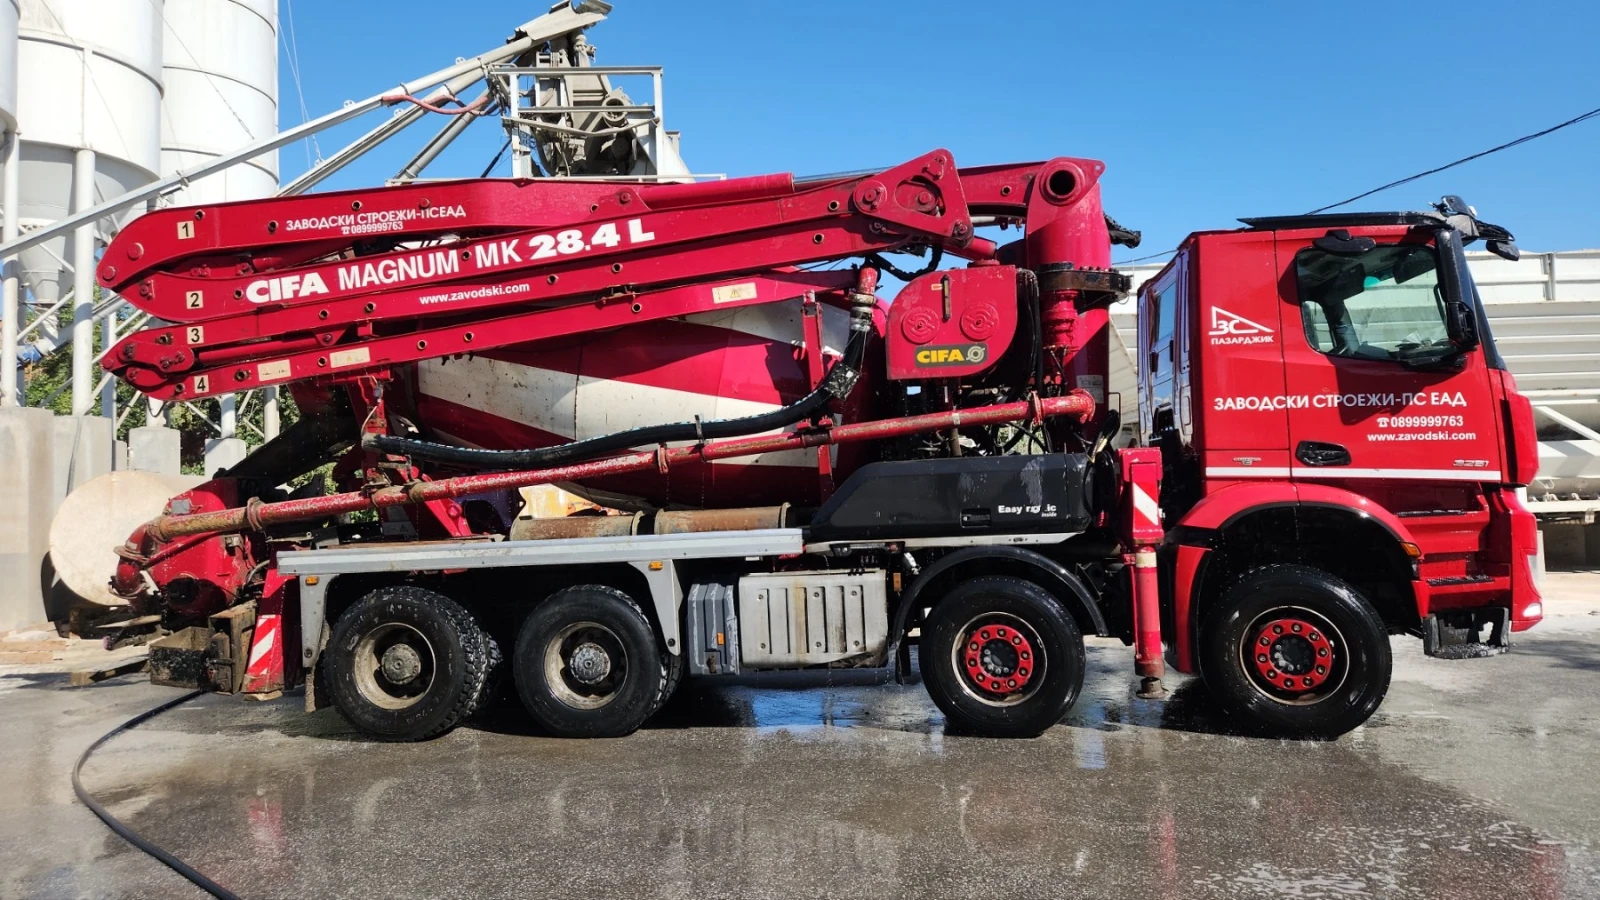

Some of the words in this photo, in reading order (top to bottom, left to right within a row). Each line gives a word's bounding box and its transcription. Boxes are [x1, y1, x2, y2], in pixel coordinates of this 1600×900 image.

[286, 214, 354, 231] ЗАВОДСКИ
[351, 221, 404, 234] 0899999763
[181, 223, 190, 237] 1
[246, 272, 330, 303] CIFA
[337, 250, 460, 291] MAGNUM
[475, 239, 522, 268] MK
[529, 222, 621, 260] 28.4
[628, 218, 655, 243] L
[189, 292, 200, 308] 2
[419, 282, 530, 305] www.zavodski.com
[190, 328, 200, 342] 3
[1211, 335, 1274, 345] ПАЗАРДЖИК
[916, 349, 965, 363] CIFA
[196, 377, 206, 391] 4
[1213, 395, 1309, 411] ЗАВОДСКИ
[1312, 392, 1427, 408] СТРОЕЖИ-ПС
[1431, 392, 1467, 407] ЕАД
[1390, 415, 1464, 428] 0899999763
[1367, 431, 1476, 441] www.zavodski.com
